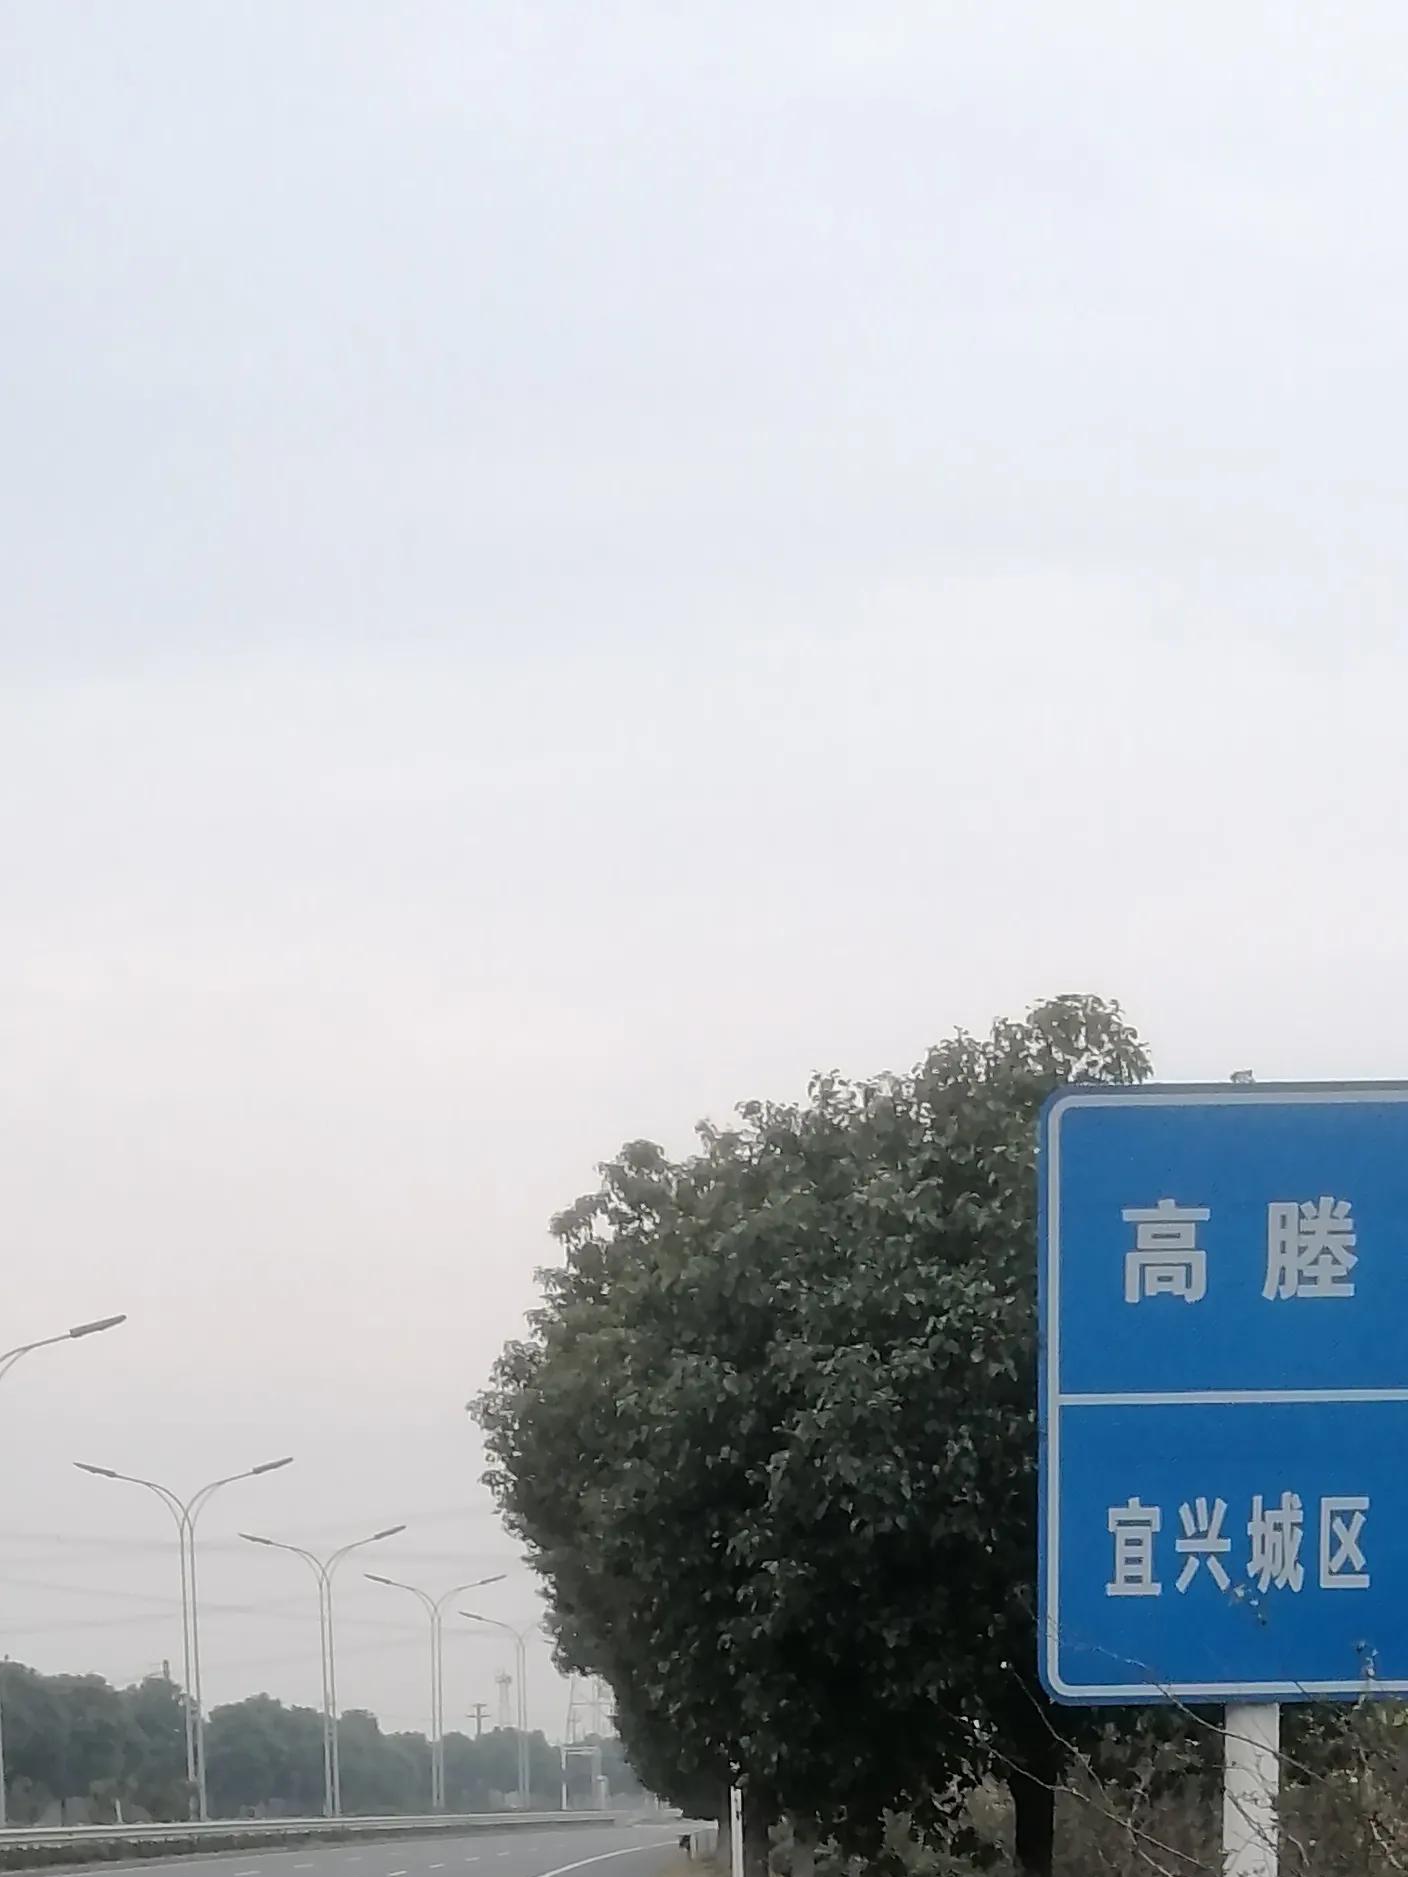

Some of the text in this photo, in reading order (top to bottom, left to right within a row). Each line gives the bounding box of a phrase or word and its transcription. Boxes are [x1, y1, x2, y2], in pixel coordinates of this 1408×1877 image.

[1120, 1195, 1359, 1305] 高塍
[1105, 1490, 1372, 1598] 宜兴城区
